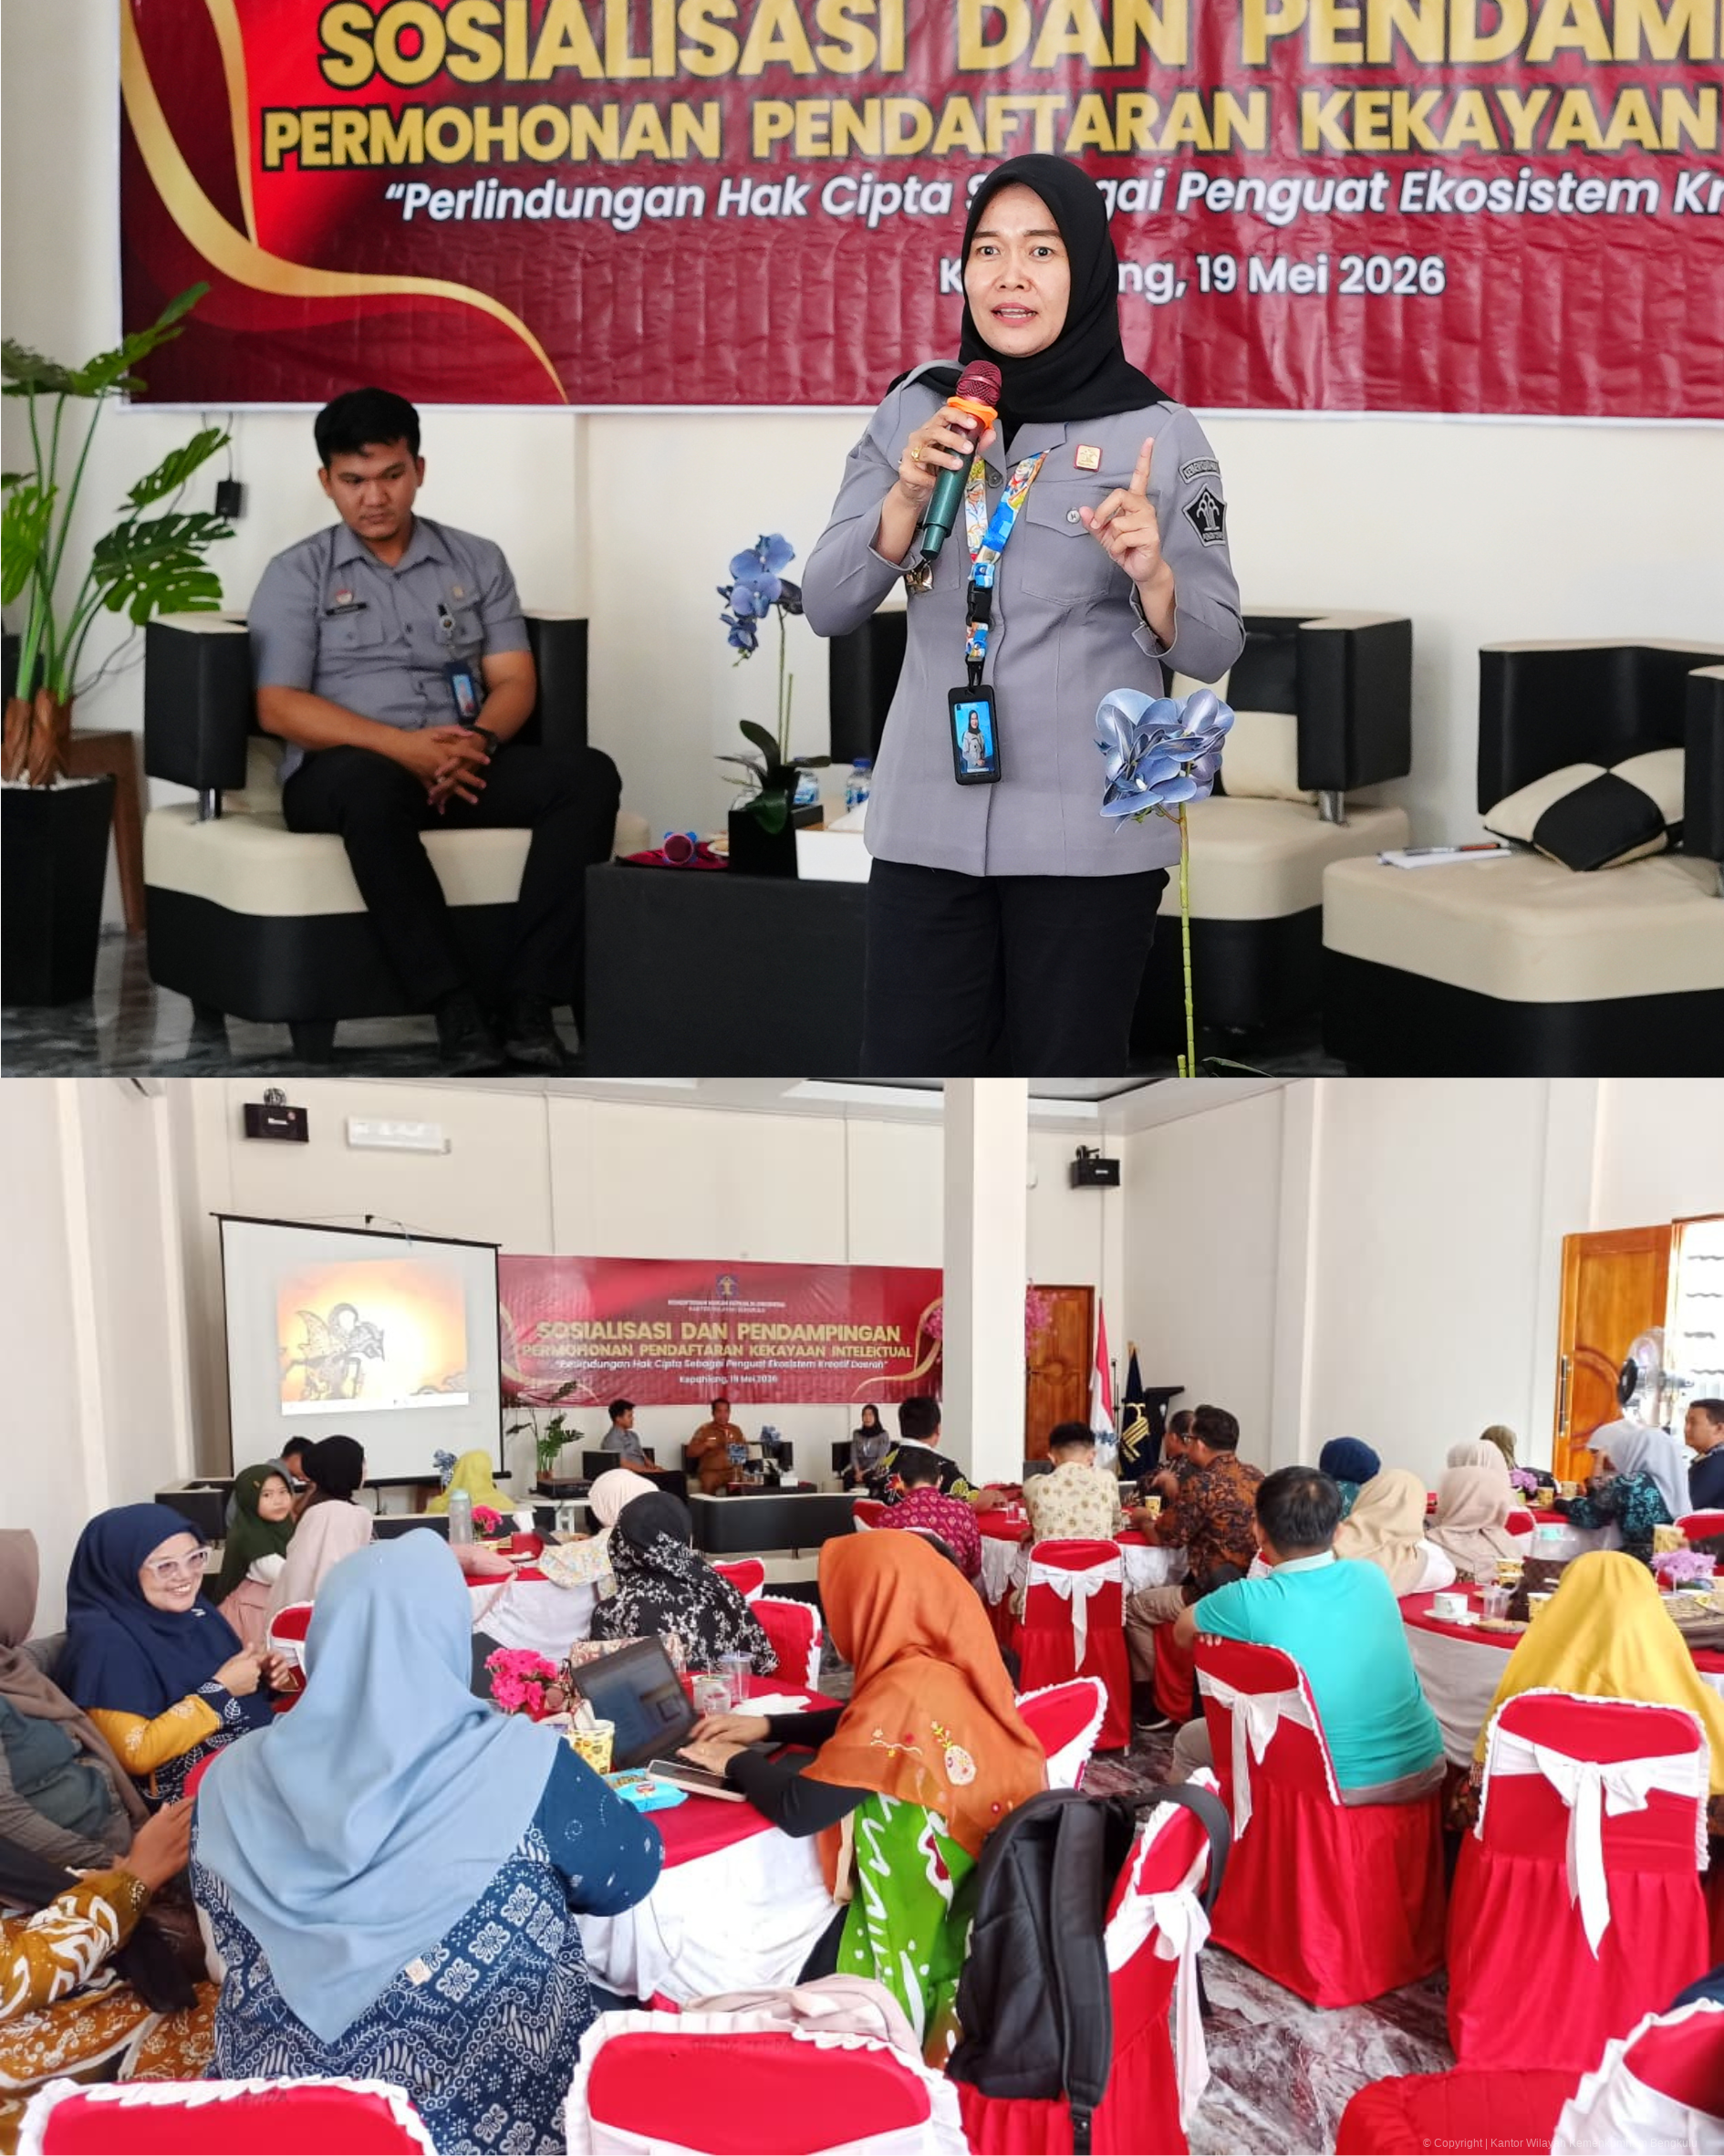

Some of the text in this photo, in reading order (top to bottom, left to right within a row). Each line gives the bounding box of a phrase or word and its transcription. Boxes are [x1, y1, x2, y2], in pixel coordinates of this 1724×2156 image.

[318, 0, 1724, 85] SOSIALISASI DAN PENDAM
[265, 88, 1719, 167] PERMOHONAN PENDAFTARAN KEKAYAAN
[718, 176, 808, 217] Hak
[821, 177, 953, 226] Cipta
[1177, 172, 1389, 224] Penguat
[1399, 168, 1660, 215] Ekosistem
[1198, 255, 1231, 295] 19
[1249, 255, 1327, 295] Mei
[1340, 255, 1446, 295] 2026
[523, 1343, 912, 1358] PERMOHONAN PENDAFTARAN KEKAYAAN INTELEKTUAL
[536, 1321, 900, 1342] SOSIALISASI DAN PENDAMPINGAN
